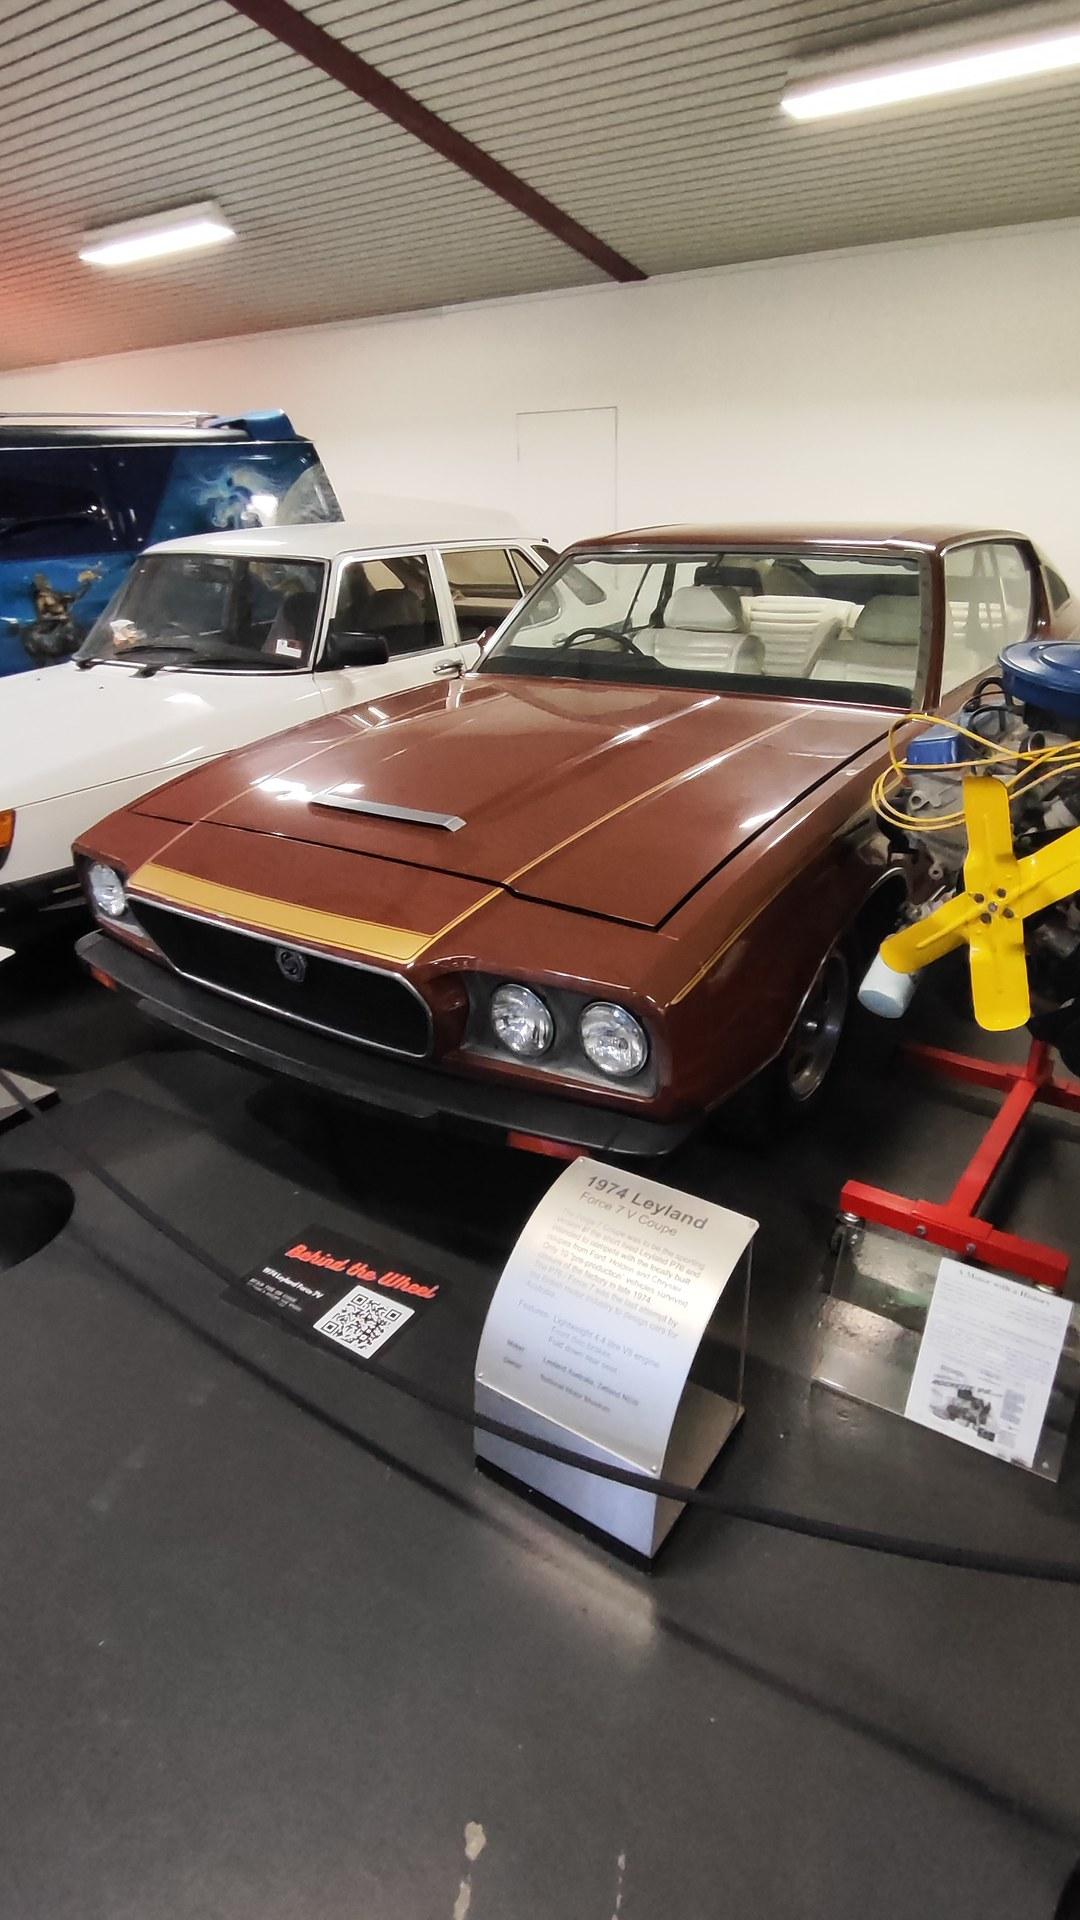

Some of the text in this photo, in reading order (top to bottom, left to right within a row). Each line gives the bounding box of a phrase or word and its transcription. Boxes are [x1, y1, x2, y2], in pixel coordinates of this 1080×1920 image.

[579, 1191, 679, 1237] Force 7 V Coupe
[588, 1176, 630, 1199] 1974
[631, 1193, 709, 1230] Leyland
[285, 1243, 440, 1299] Behind the Wheel
